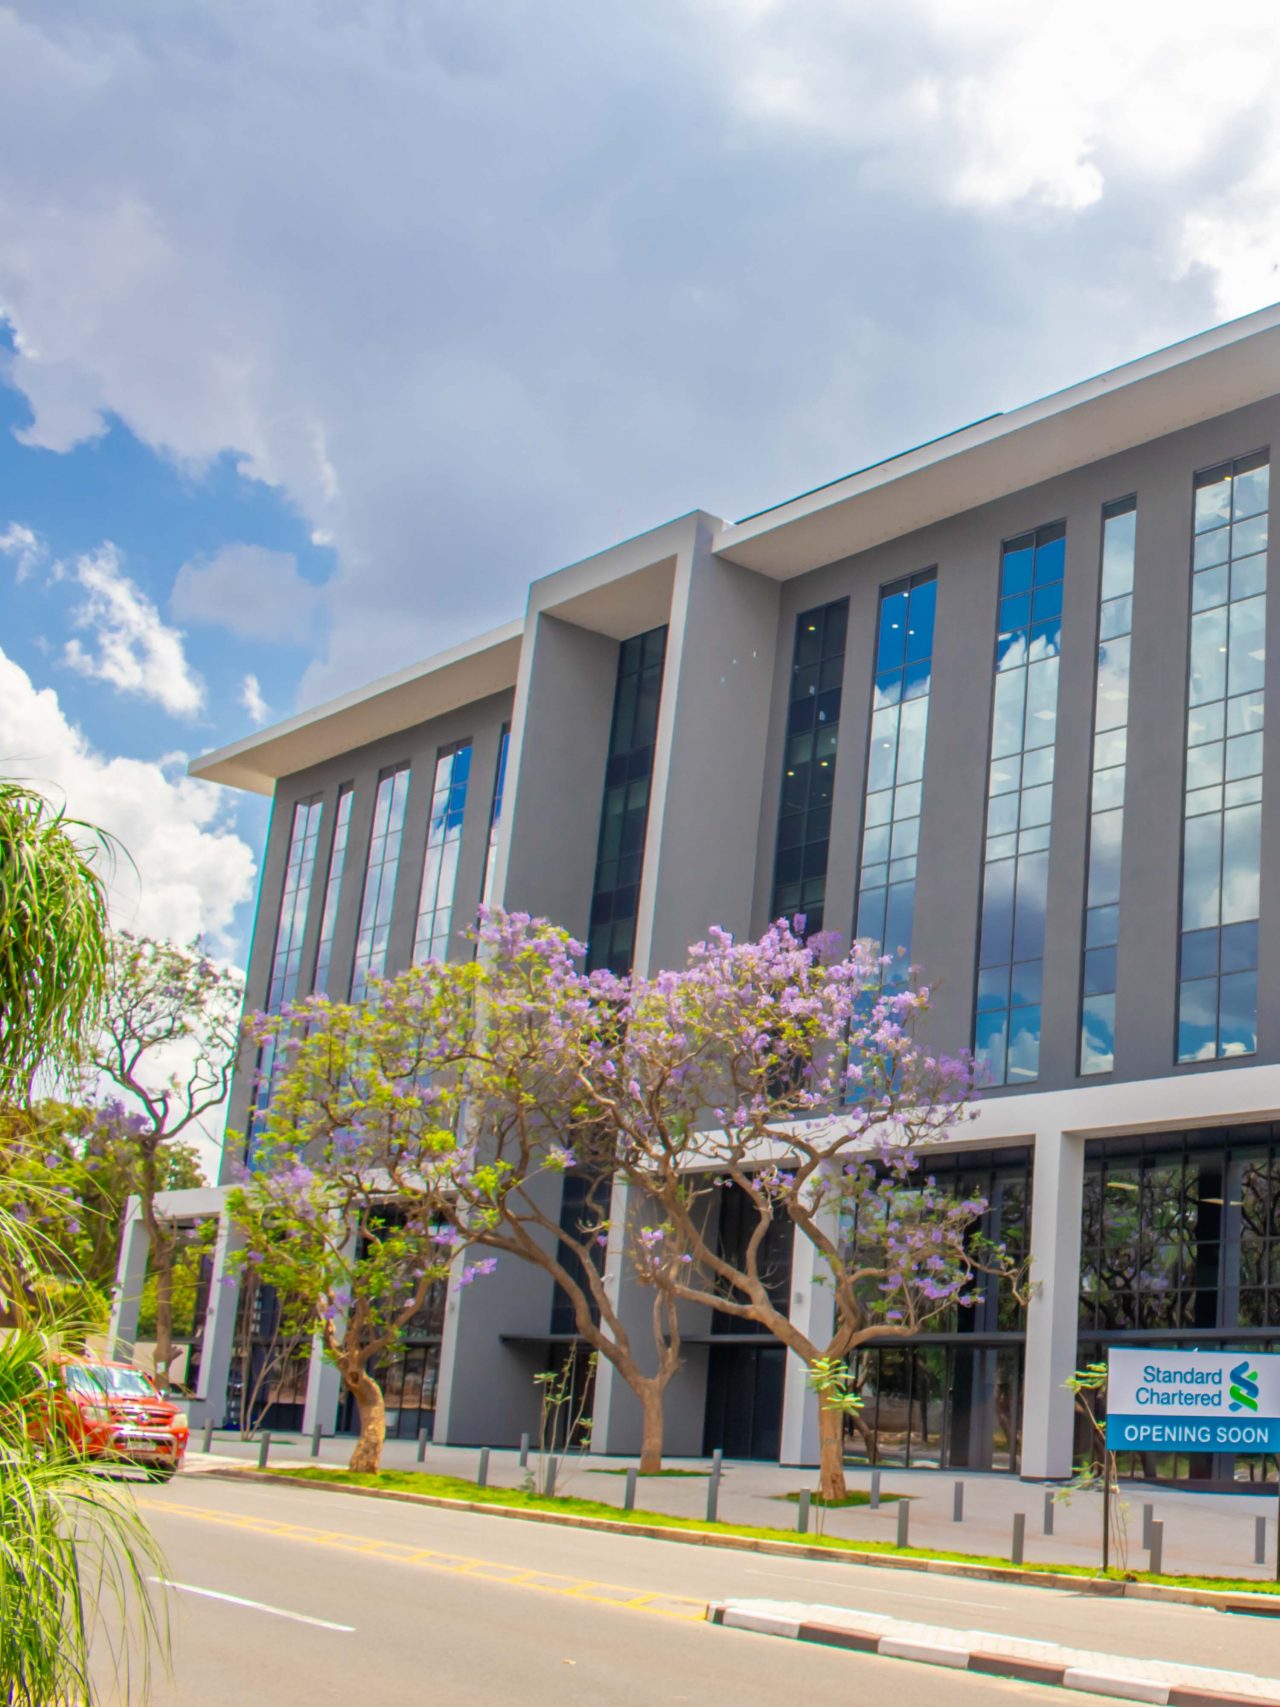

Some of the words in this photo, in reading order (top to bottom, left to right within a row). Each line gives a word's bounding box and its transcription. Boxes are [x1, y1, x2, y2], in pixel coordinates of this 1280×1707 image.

[1143, 1365, 1222, 1385] Standard
[1135, 1387, 1222, 1406] Chartered
[1124, 1424, 1211, 1443] OPENING
[1216, 1427, 1269, 1444] SOON
